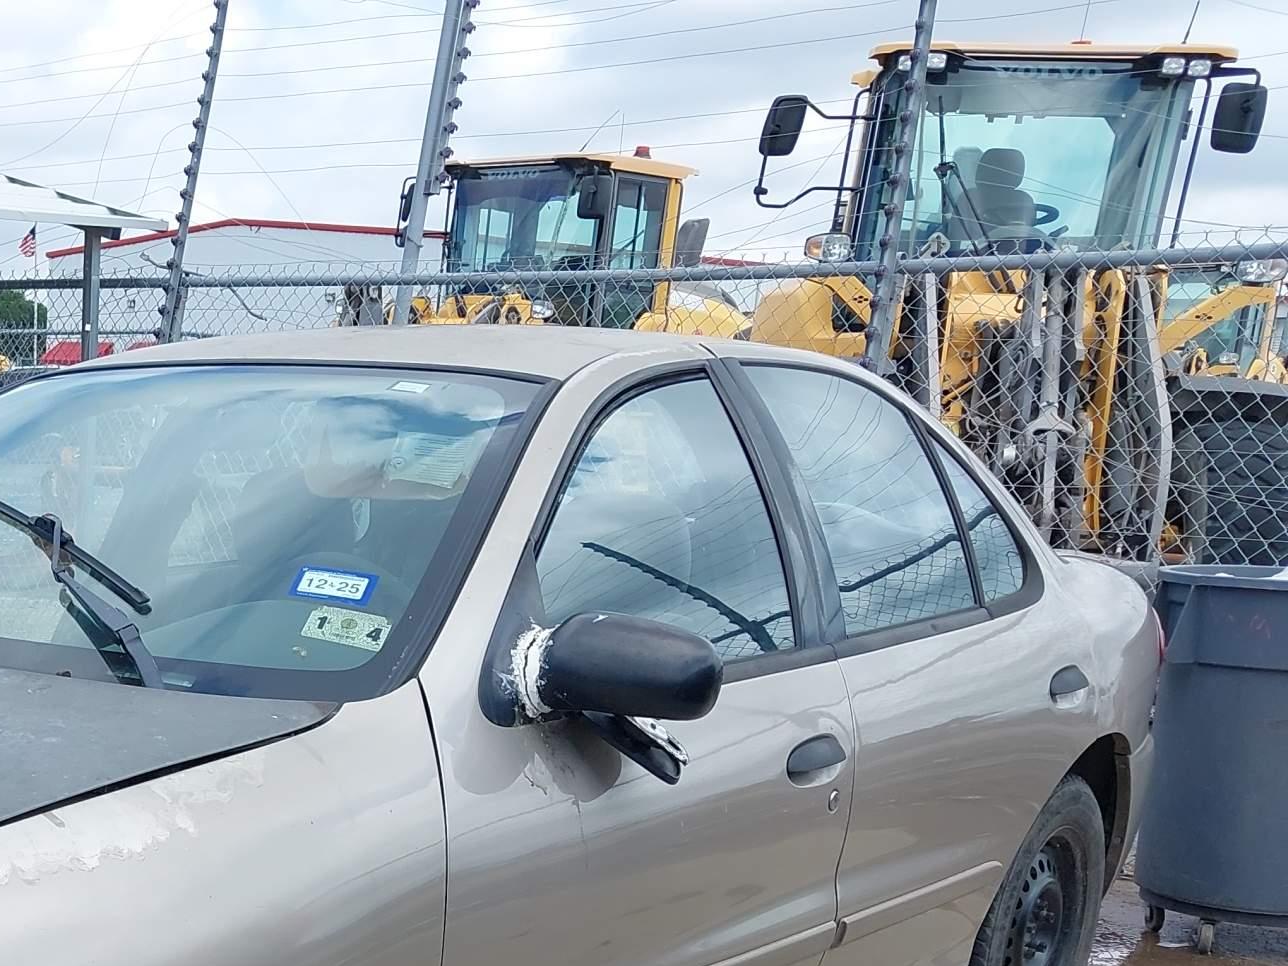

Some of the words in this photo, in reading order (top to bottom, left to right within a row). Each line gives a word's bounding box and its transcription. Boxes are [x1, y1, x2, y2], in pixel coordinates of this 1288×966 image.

[999, 65, 1104, 80] VOLVO
[306, 577, 329, 590] 12
[336, 581, 362, 595] 25
